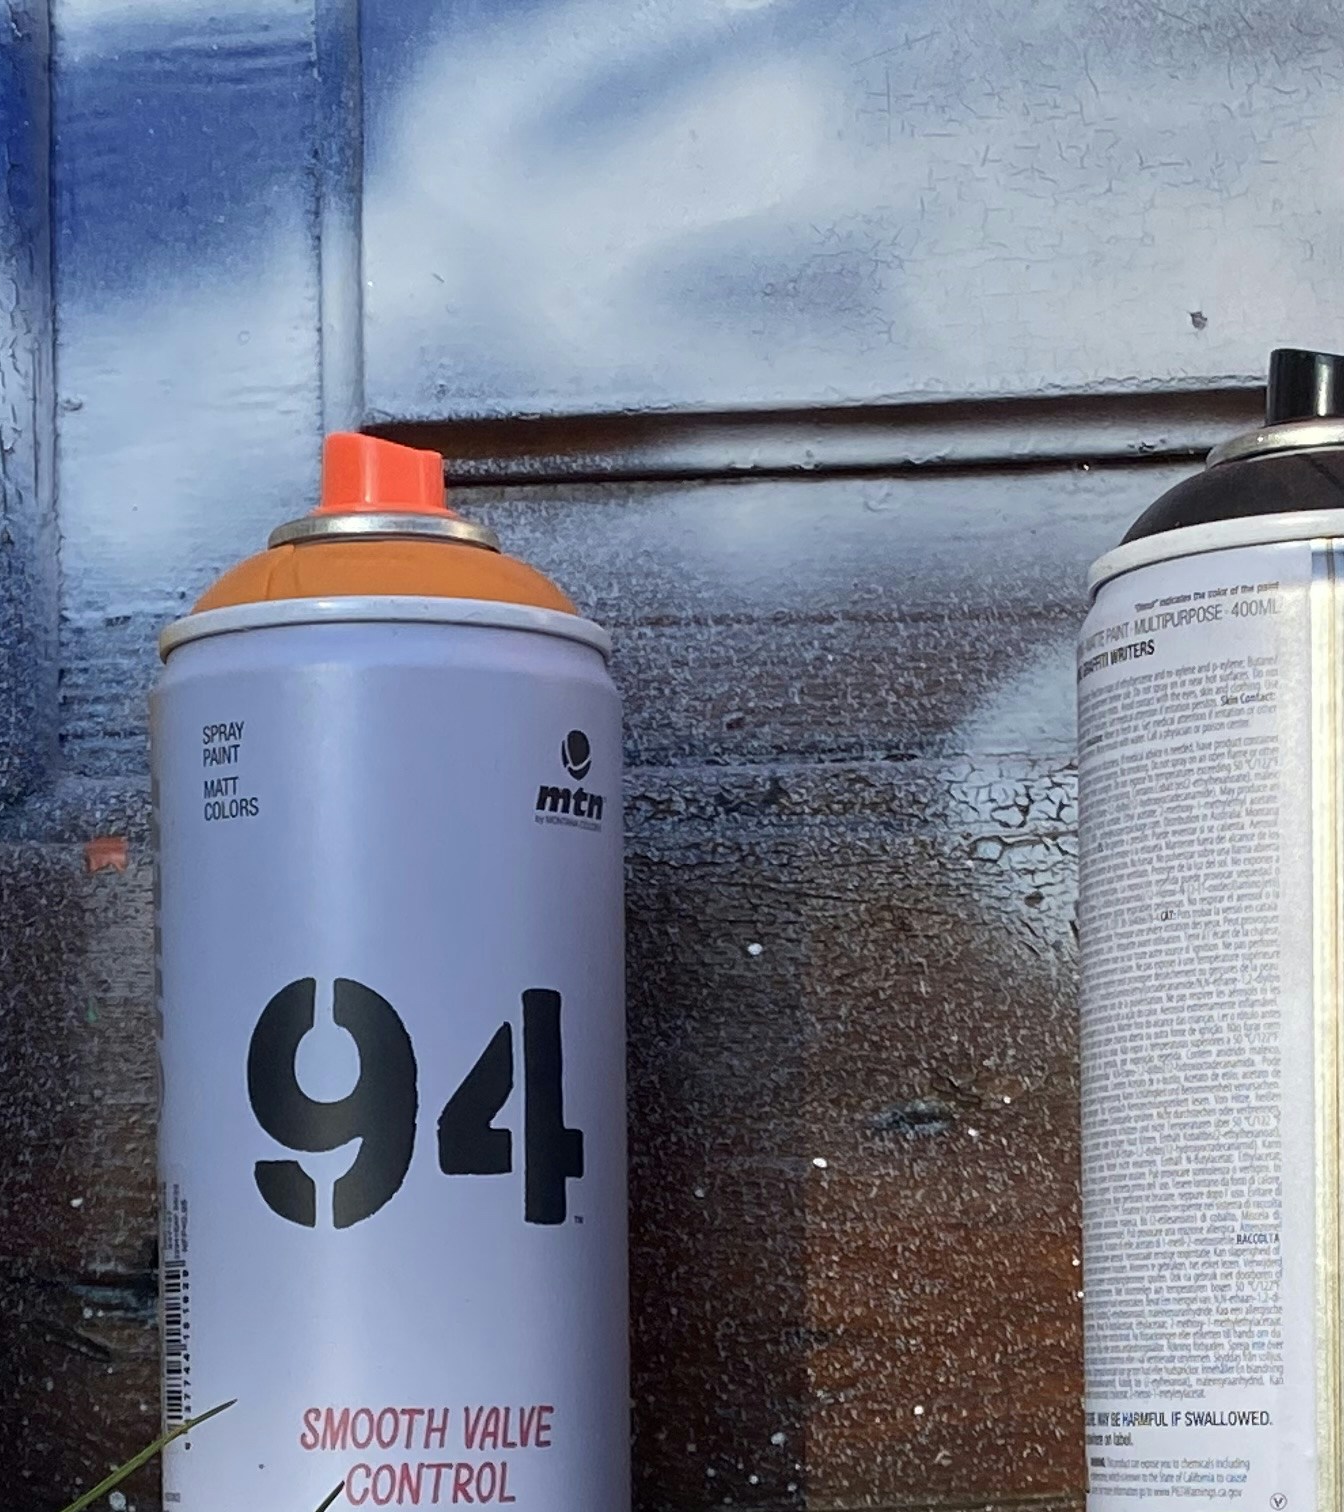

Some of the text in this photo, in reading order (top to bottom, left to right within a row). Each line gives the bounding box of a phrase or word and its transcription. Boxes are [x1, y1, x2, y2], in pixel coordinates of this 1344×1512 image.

[1193, 591, 1206, 601] the
[1208, 587, 1227, 599] color
[1230, 585, 1239, 596] of
[1241, 584, 1255, 595] the
[1133, 603, 1223, 635] MULTIPURPOSE
[1231, 598, 1281, 618] 400ML
[1109, 639, 1155, 665] WRITERS
[202, 720, 245, 745] SPRAY
[202, 743, 241, 767] PAINT
[203, 776, 240, 799] MATT
[204, 796, 260, 821] COLORS
[535, 785, 604, 820] mtn
[246, 976, 584, 1230] 94
[299, 1404, 555, 1453] SMOOTH VALVE
[1110, 1411, 1121, 1427] BE
[1122, 1411, 1169, 1427] HARMFUL
[1171, 1411, 1181, 1427] IF
[1184, 1409, 1274, 1427] SWALLOWED.
[1112, 1431, 1134, 1447] label.
[1181, 1456, 1251, 1472] chemicals including
[344, 1461, 517, 1506] CONTROL
[1182, 1472, 1215, 1484] California
[1225, 1473, 1248, 1484] cause
